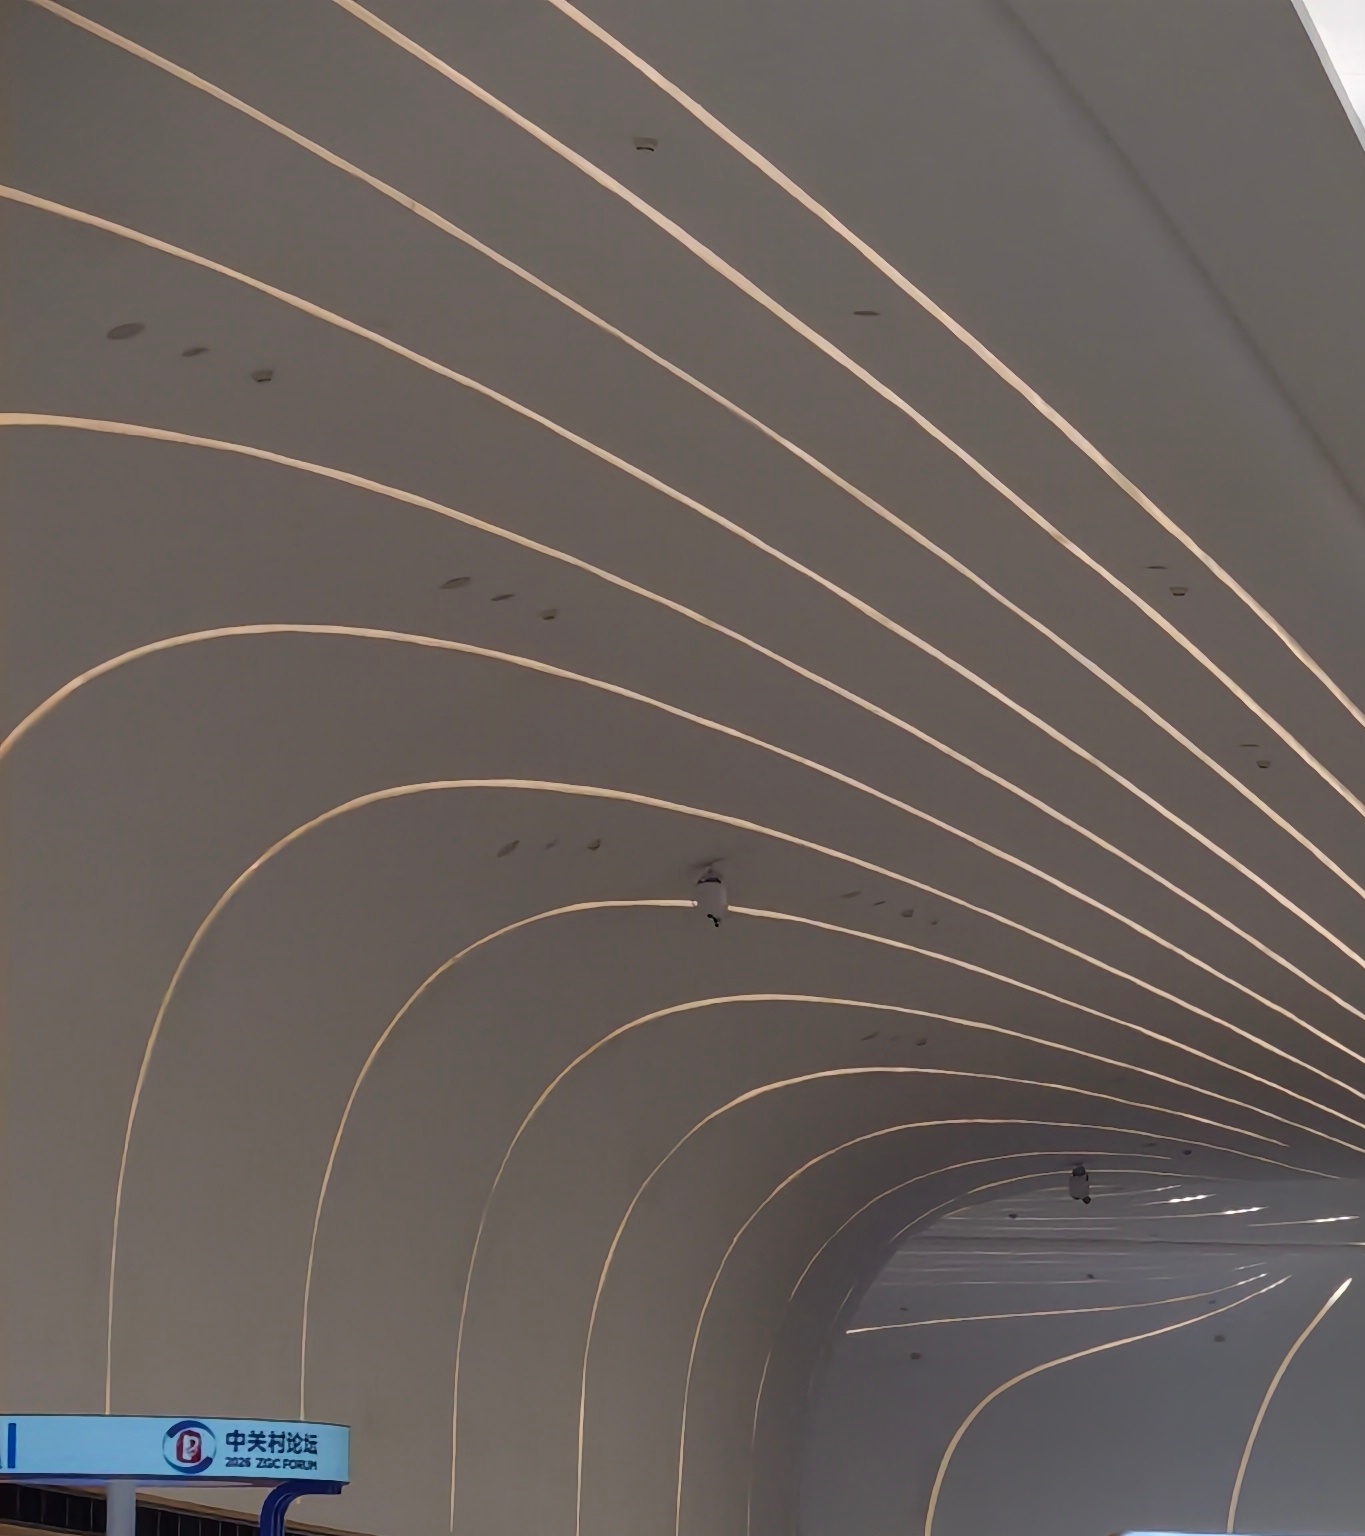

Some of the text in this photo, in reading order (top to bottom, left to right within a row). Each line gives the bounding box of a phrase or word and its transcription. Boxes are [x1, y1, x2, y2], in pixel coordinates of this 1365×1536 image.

[225, 1429, 318, 1455] 中关村论坛
[255, 1458, 281, 1469] ZGC
[283, 1459, 318, 1471] FORUM
